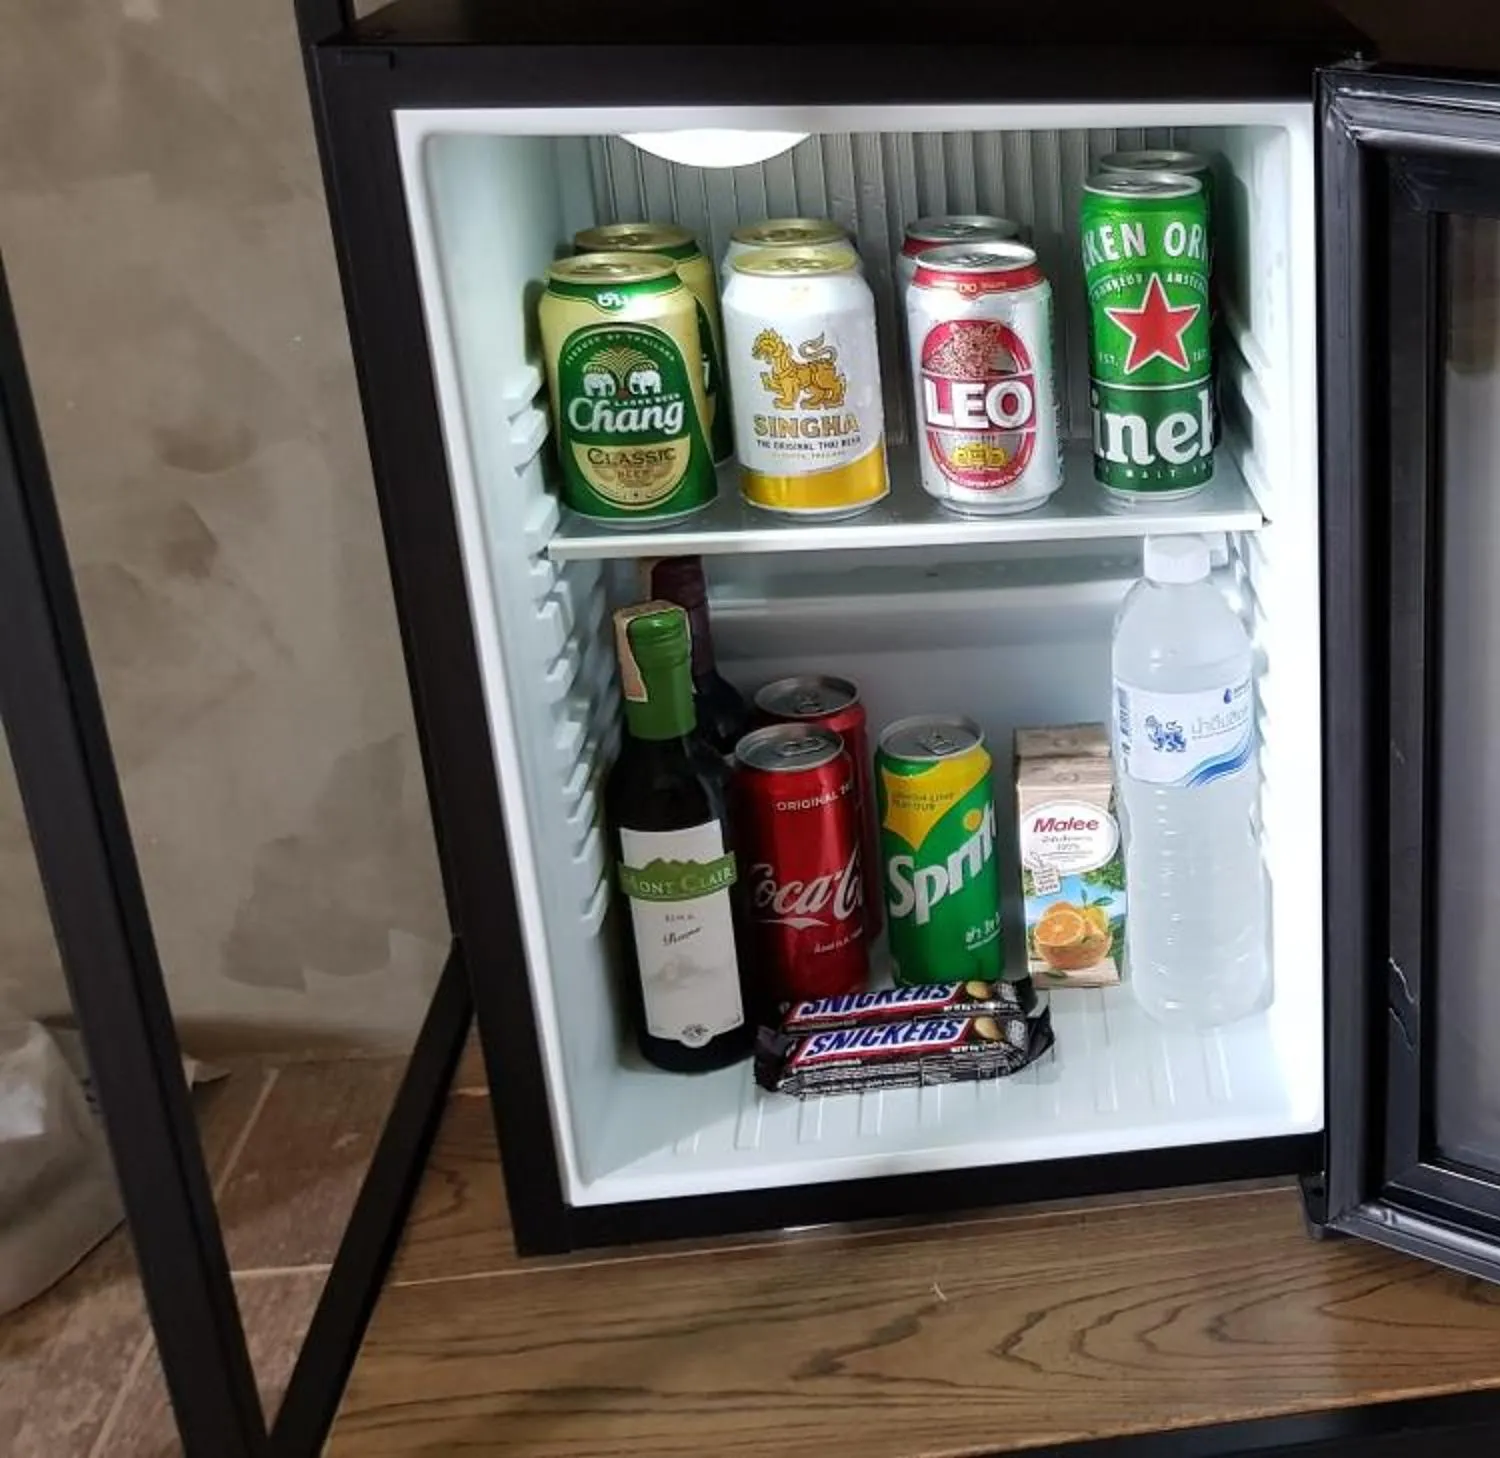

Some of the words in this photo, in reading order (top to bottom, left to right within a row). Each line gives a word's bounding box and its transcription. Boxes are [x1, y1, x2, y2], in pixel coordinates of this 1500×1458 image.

[568, 397, 685, 435] Chang
[924, 379, 1034, 430] LEO
[753, 414, 860, 438] SINGHA
[587, 447, 677, 465] CLASSIC
[777, 790, 839, 811] ORIGINAL
[1033, 816, 1100, 833] Malee
[800, 983, 952, 1016] SNICKERS
[806, 1019, 961, 1056] SNICKERS
